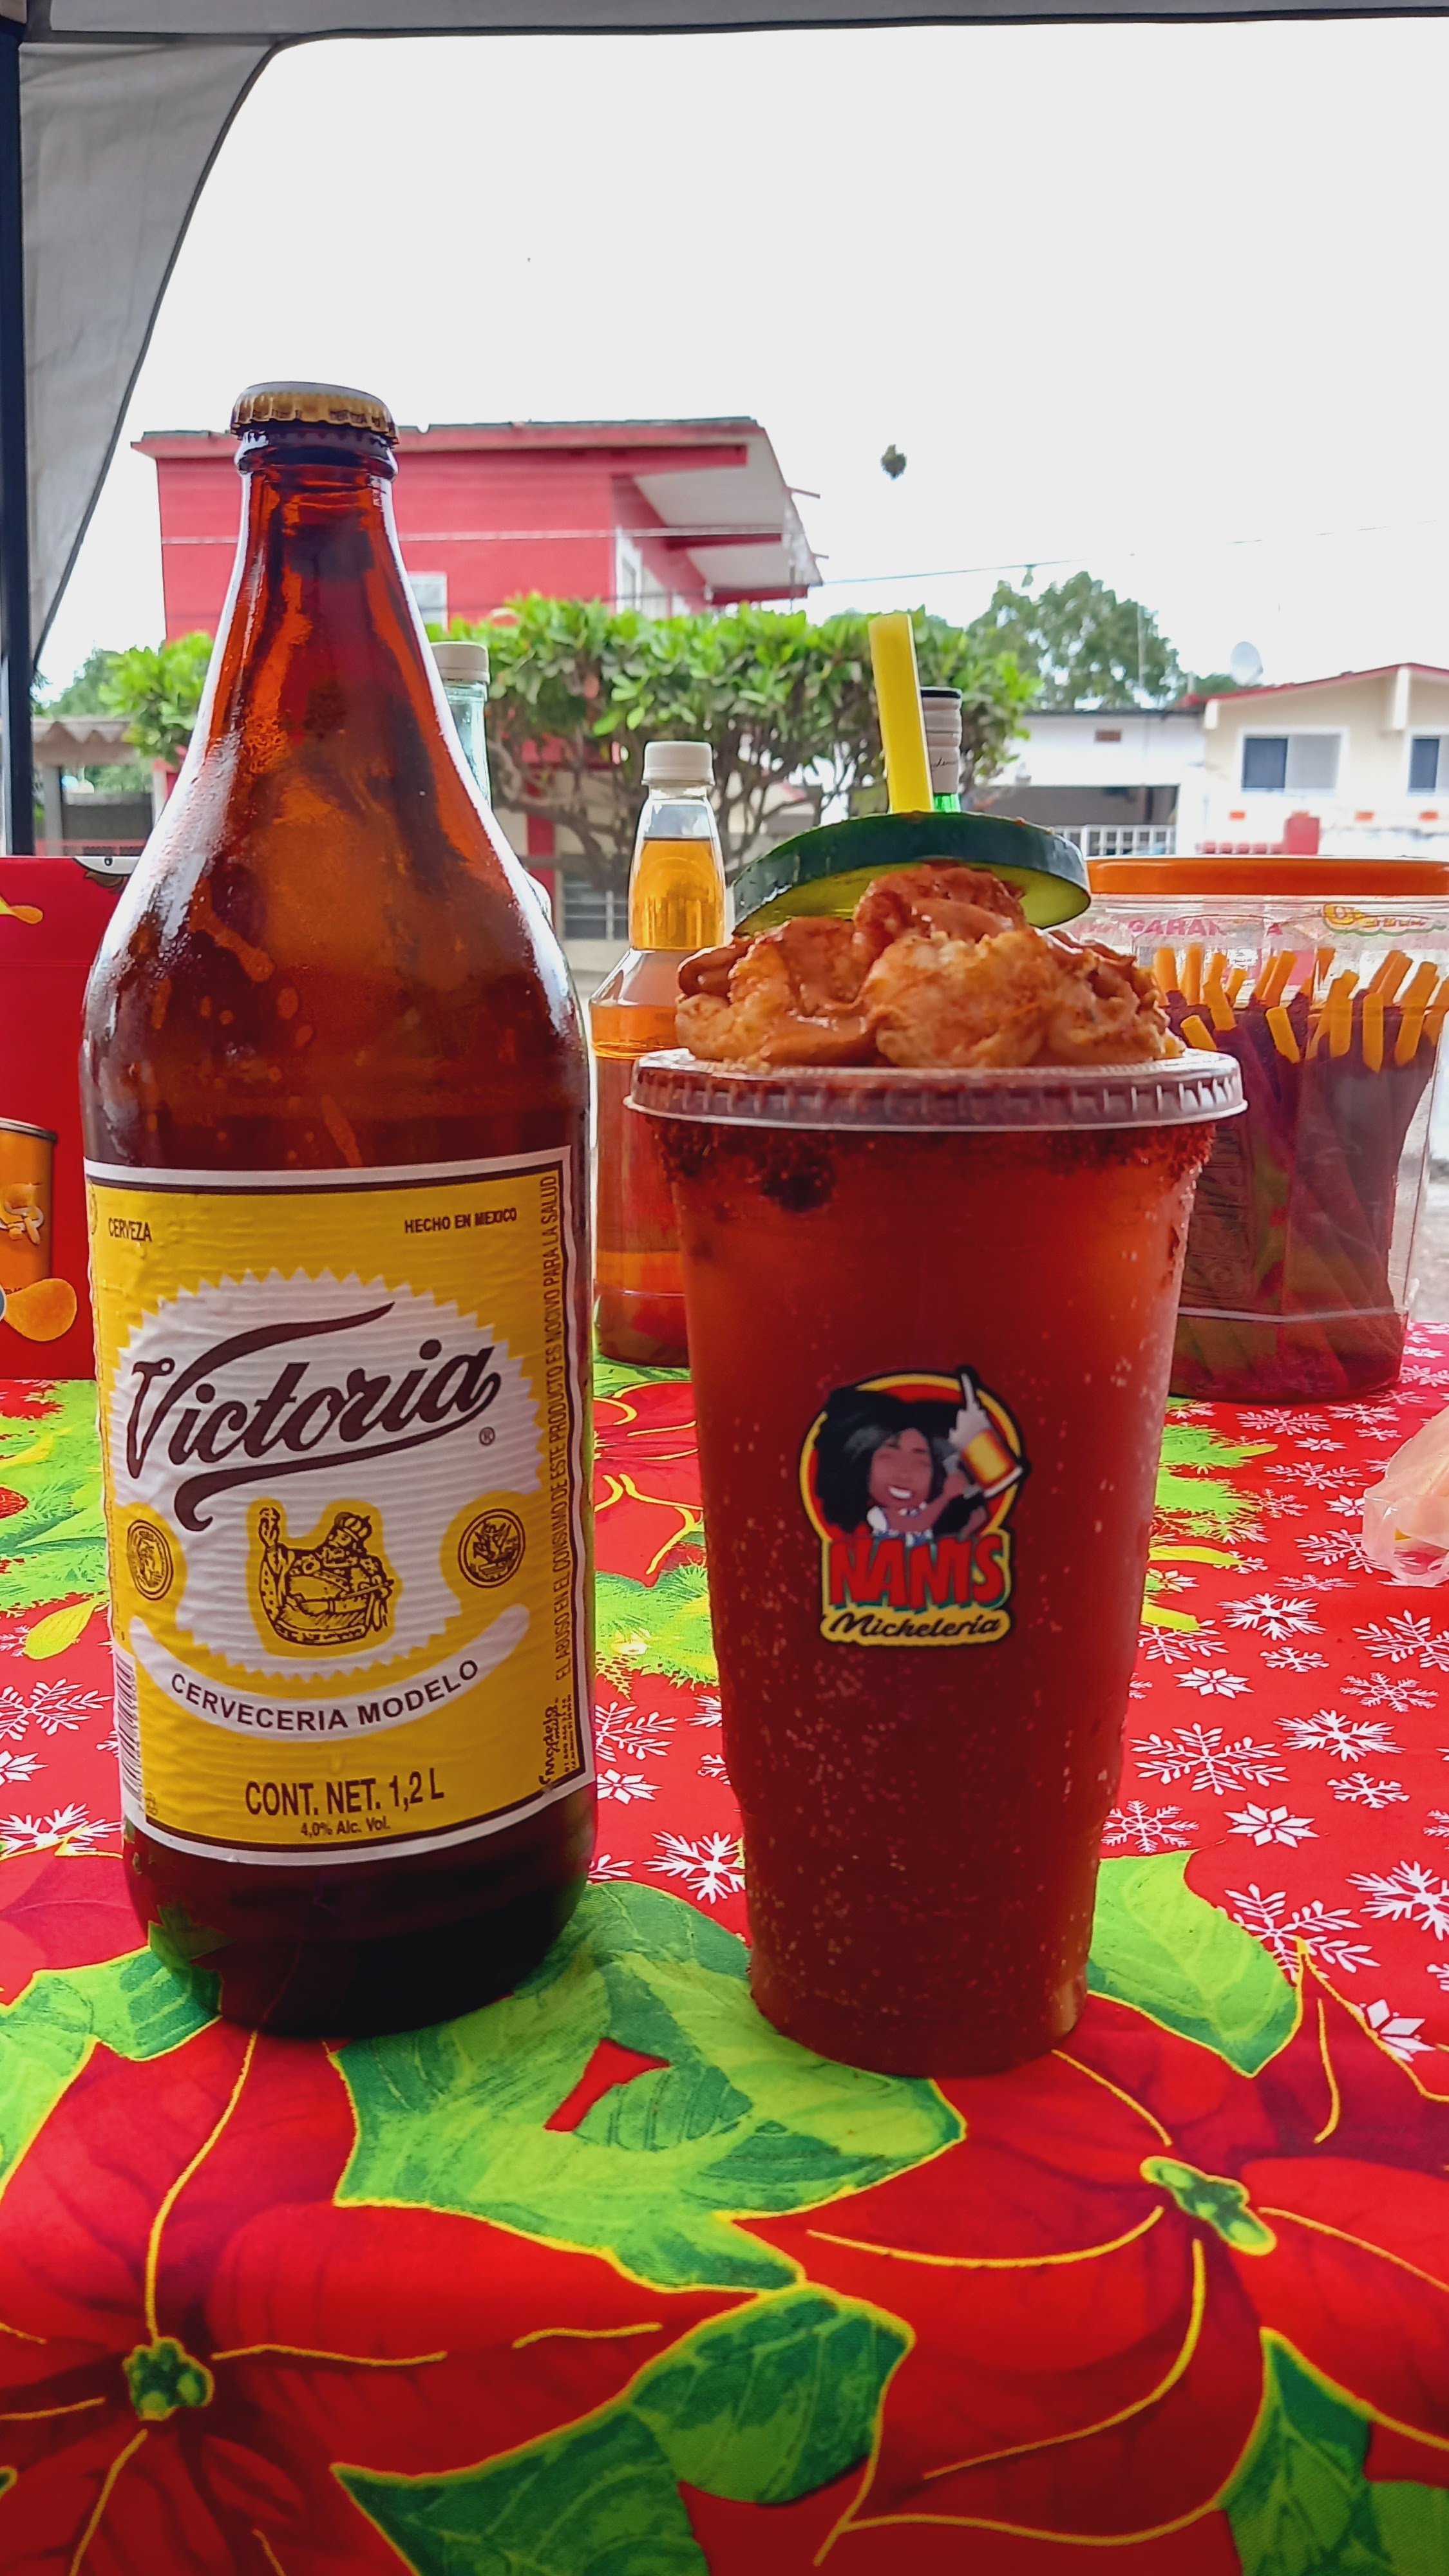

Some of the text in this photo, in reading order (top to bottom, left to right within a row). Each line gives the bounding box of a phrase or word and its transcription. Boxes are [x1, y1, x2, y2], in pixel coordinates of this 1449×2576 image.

[540, 1175, 558, 1225] SALUD
[108, 1217, 152, 1242] CERVEZA
[404, 1208, 517, 1233] HECHO EN MEXICO
[541, 1228, 558, 1248] LA
[542, 1248, 561, 1287] PARA
[545, 1345, 563, 1365] ES
[127, 1302, 501, 1531] Victoria
[546, 1366, 567, 1444] PRODUCTO
[548, 1441, 567, 1479] ESTE
[549, 1479, 567, 1499] DE
[553, 1572, 569, 1592] EL
[553, 1591, 569, 1612] EN
[553, 1612, 571, 1660] ABUSO
[554, 1660, 571, 1681] EL
[171, 1660, 479, 1732] CERVECERIA MODELO
[245, 1767, 444, 1816] CONT. NET. 1,2 L
[300, 1815, 391, 1838] 4,0% Alc. Vol.
